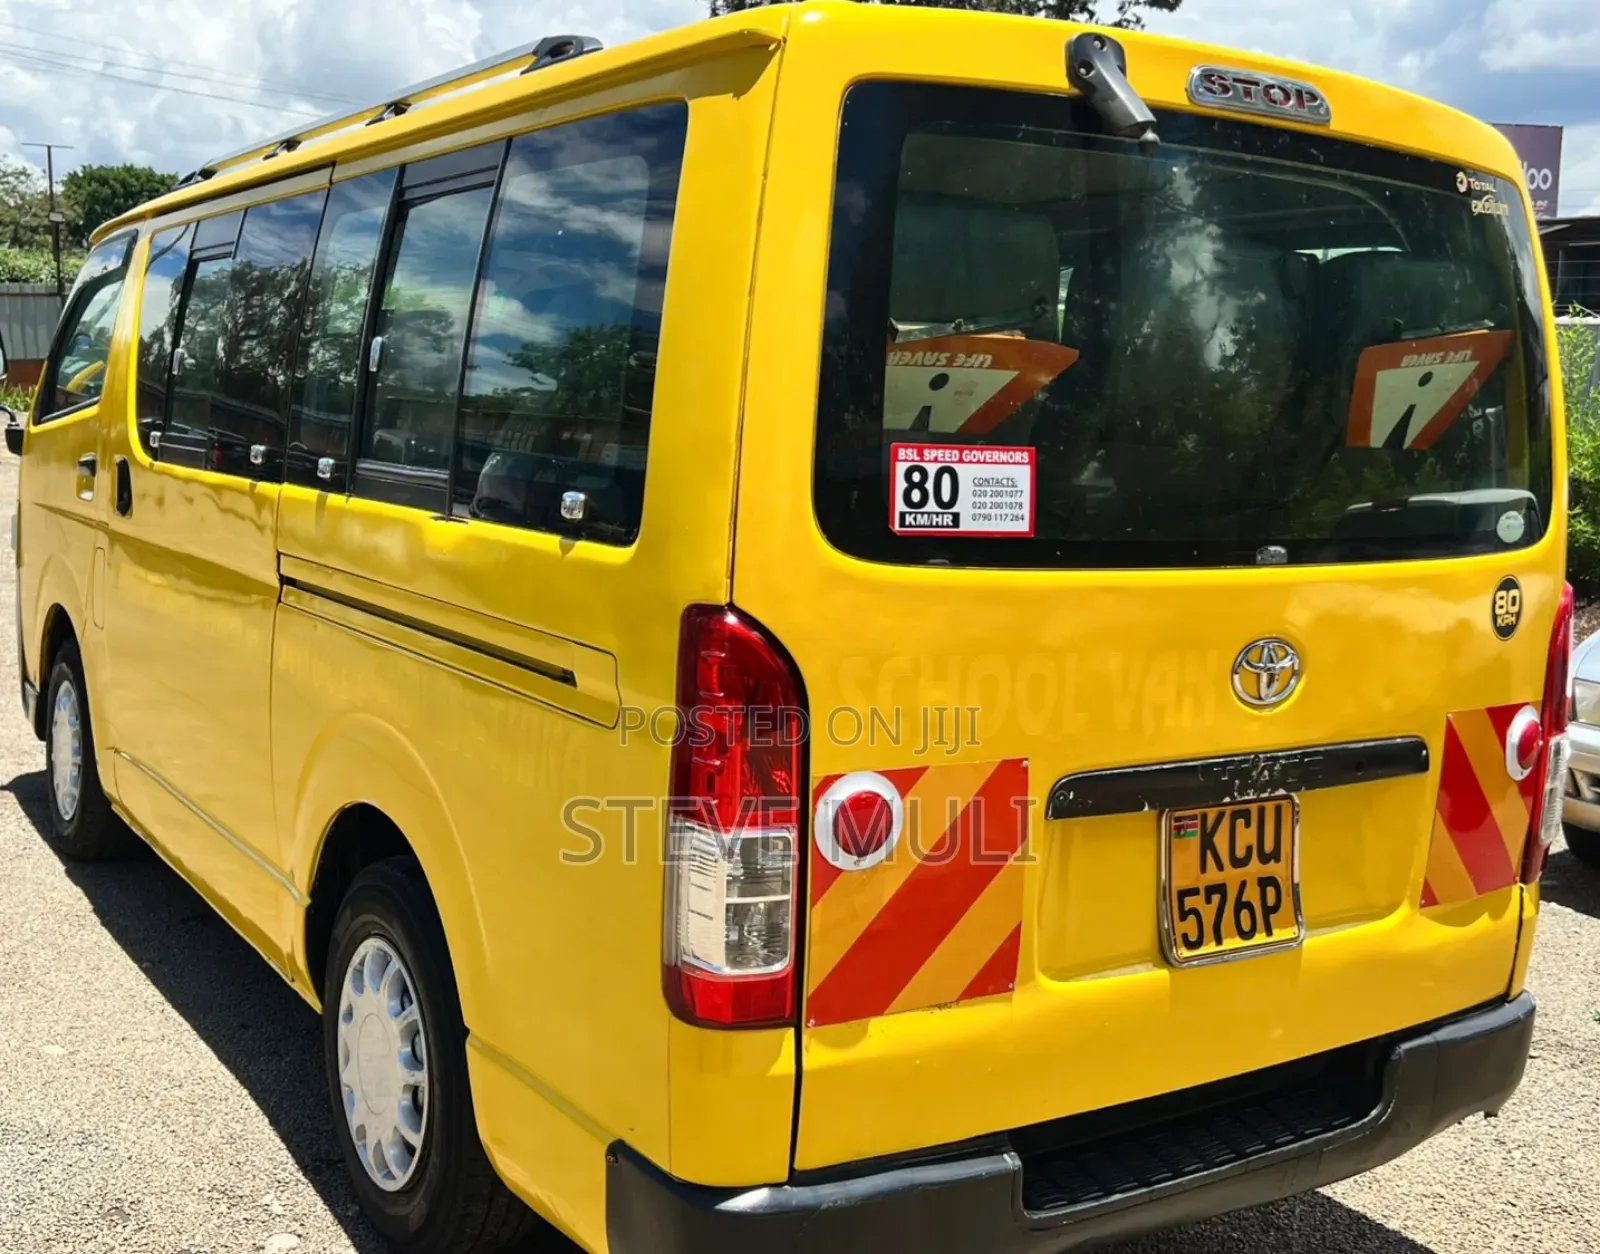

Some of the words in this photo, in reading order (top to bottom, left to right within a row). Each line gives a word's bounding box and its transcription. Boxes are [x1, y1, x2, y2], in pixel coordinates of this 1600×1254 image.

[1203, 73, 1320, 111] STOP
[1468, 178, 1496, 193] TOTAL
[886, 351, 951, 367] SAVER
[953, 353, 993, 368] LIFE
[898, 448, 920, 461] BSL
[923, 449, 960, 462] SPEED
[962, 450, 1029, 463] GOVERNORS
[902, 464, 960, 510] 80
[972, 477, 1018, 487] CONTACTS:
[972, 489, 987, 498] 020
[989, 490, 1024, 499] 2001077
[972, 501, 987, 510] 020
[989, 501, 1023, 510] 2001078
[905, 513, 954, 526] KM/HR
[972, 512, 992, 522] 0790
[994, 513, 1008, 521] 117
[1010, 513, 1025, 522] 264
[1495, 588, 1520, 615] 80
[1496, 615, 1516, 627] KPH
[837, 651, 1090, 739] SCHOOL
[1200, 804, 1282, 874] KCU
[1176, 876, 1282, 951] 576P
